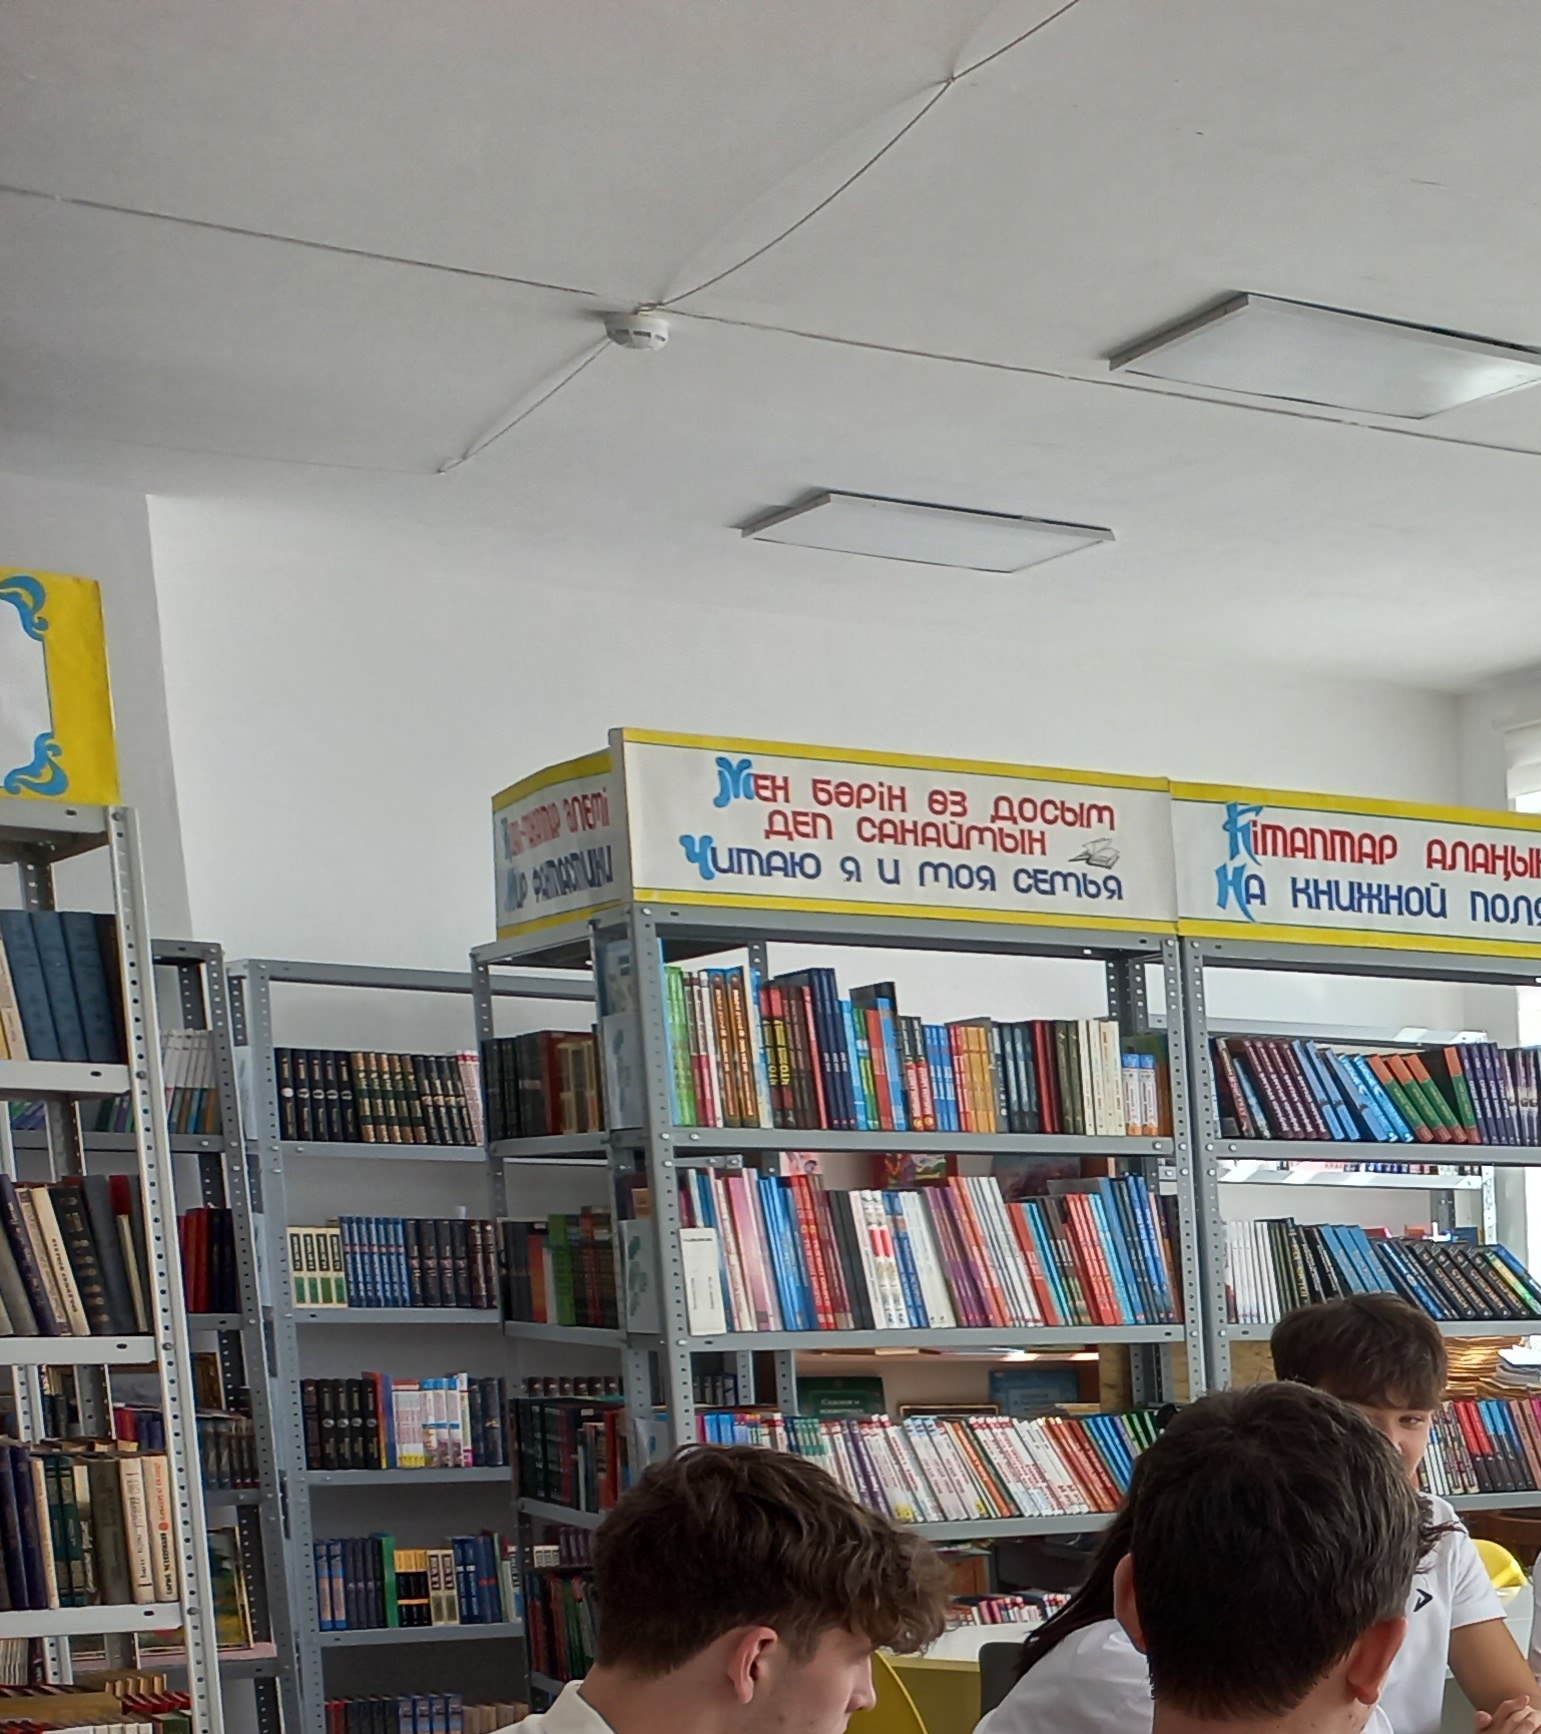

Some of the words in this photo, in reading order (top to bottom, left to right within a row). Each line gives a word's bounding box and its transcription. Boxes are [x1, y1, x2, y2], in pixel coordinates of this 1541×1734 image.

[811, 778, 907, 813] БӘРІН
[928, 789, 968, 817] ӨЗ
[990, 795, 1115, 831] ДОСЫМ
[764, 810, 833, 841] ДЕП
[856, 816, 1047, 856] САНАЙМЫН
[839, 855, 862, 883] Я
[878, 857, 900, 885] И
[918, 862, 996, 892] МОЯ
[1013, 867, 1124, 901] СЕМЬЯ
[1290, 876, 1447, 920] КНИЖНОЙ
